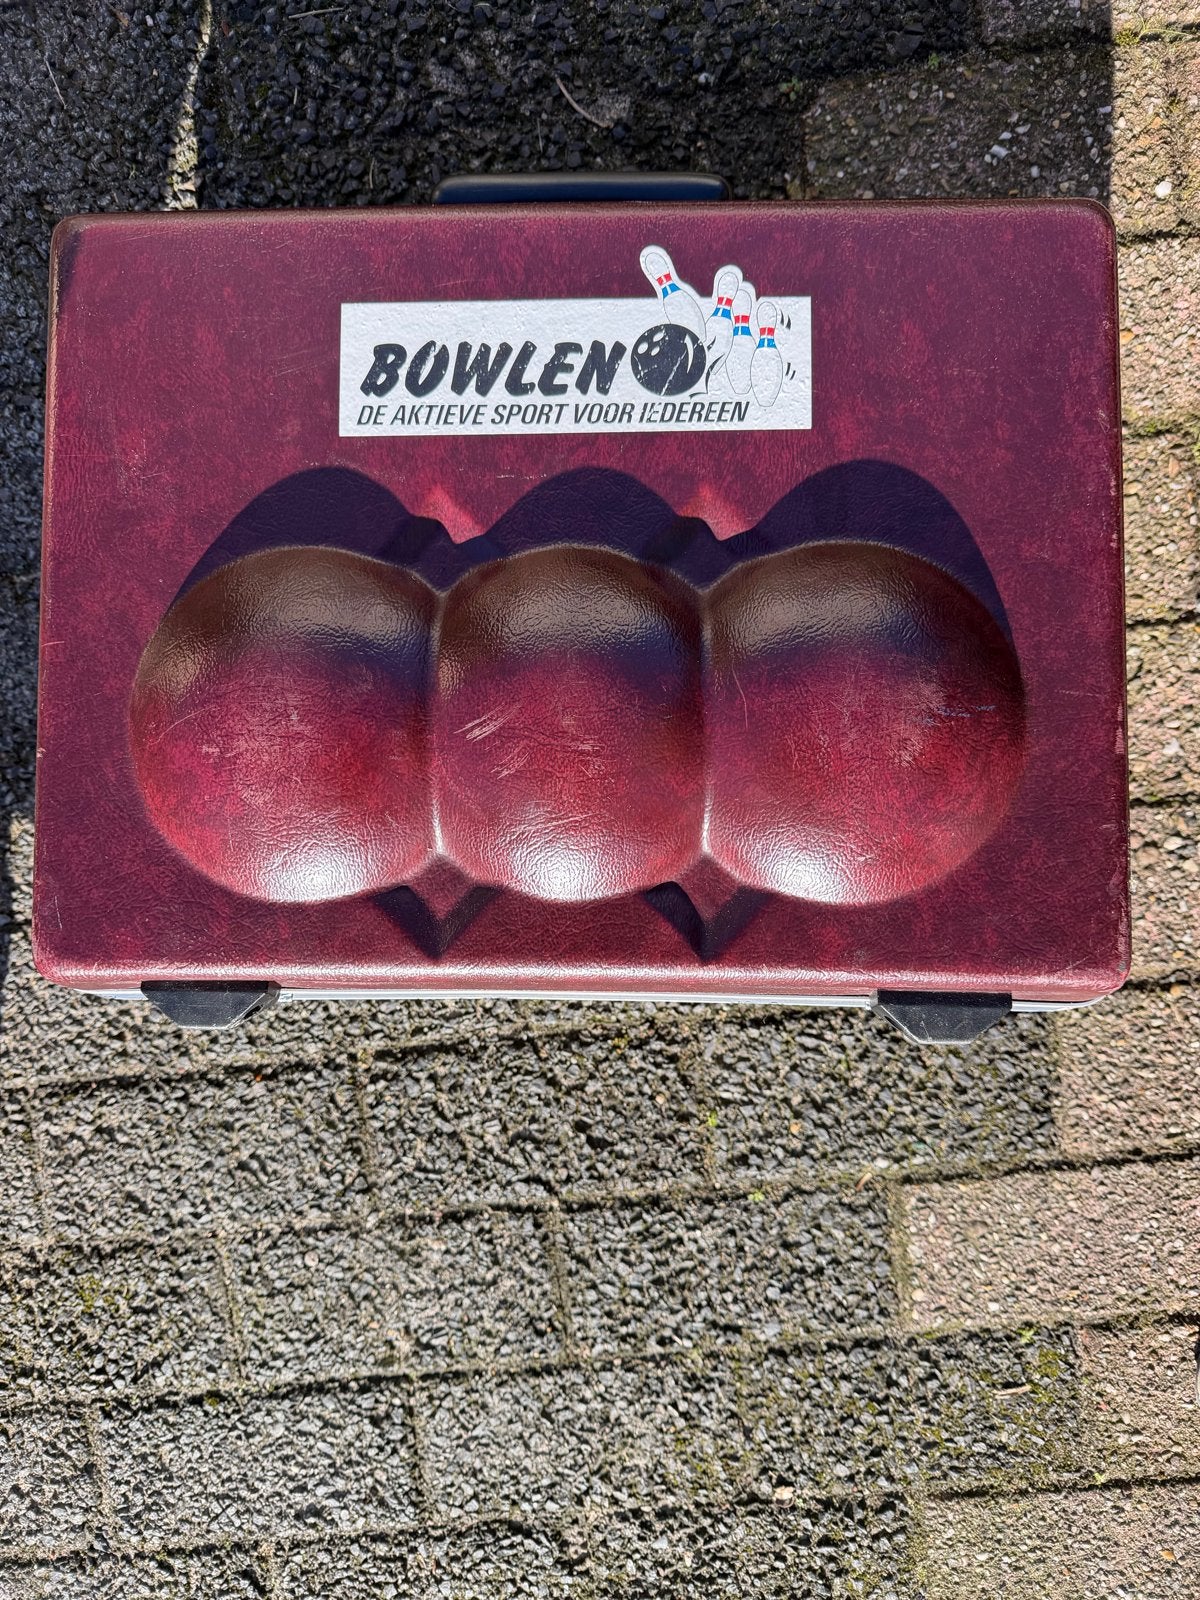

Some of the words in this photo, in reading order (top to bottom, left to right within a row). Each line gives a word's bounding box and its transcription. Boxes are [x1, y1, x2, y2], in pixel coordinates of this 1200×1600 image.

[360, 340, 627, 397] BOWLEN
[356, 405, 388, 425] DE
[390, 404, 487, 425] AKTIEVE
[491, 403, 569, 424] SPORT
[574, 402, 635, 424] VOOR
[638, 401, 750, 424] IEDEREEN
